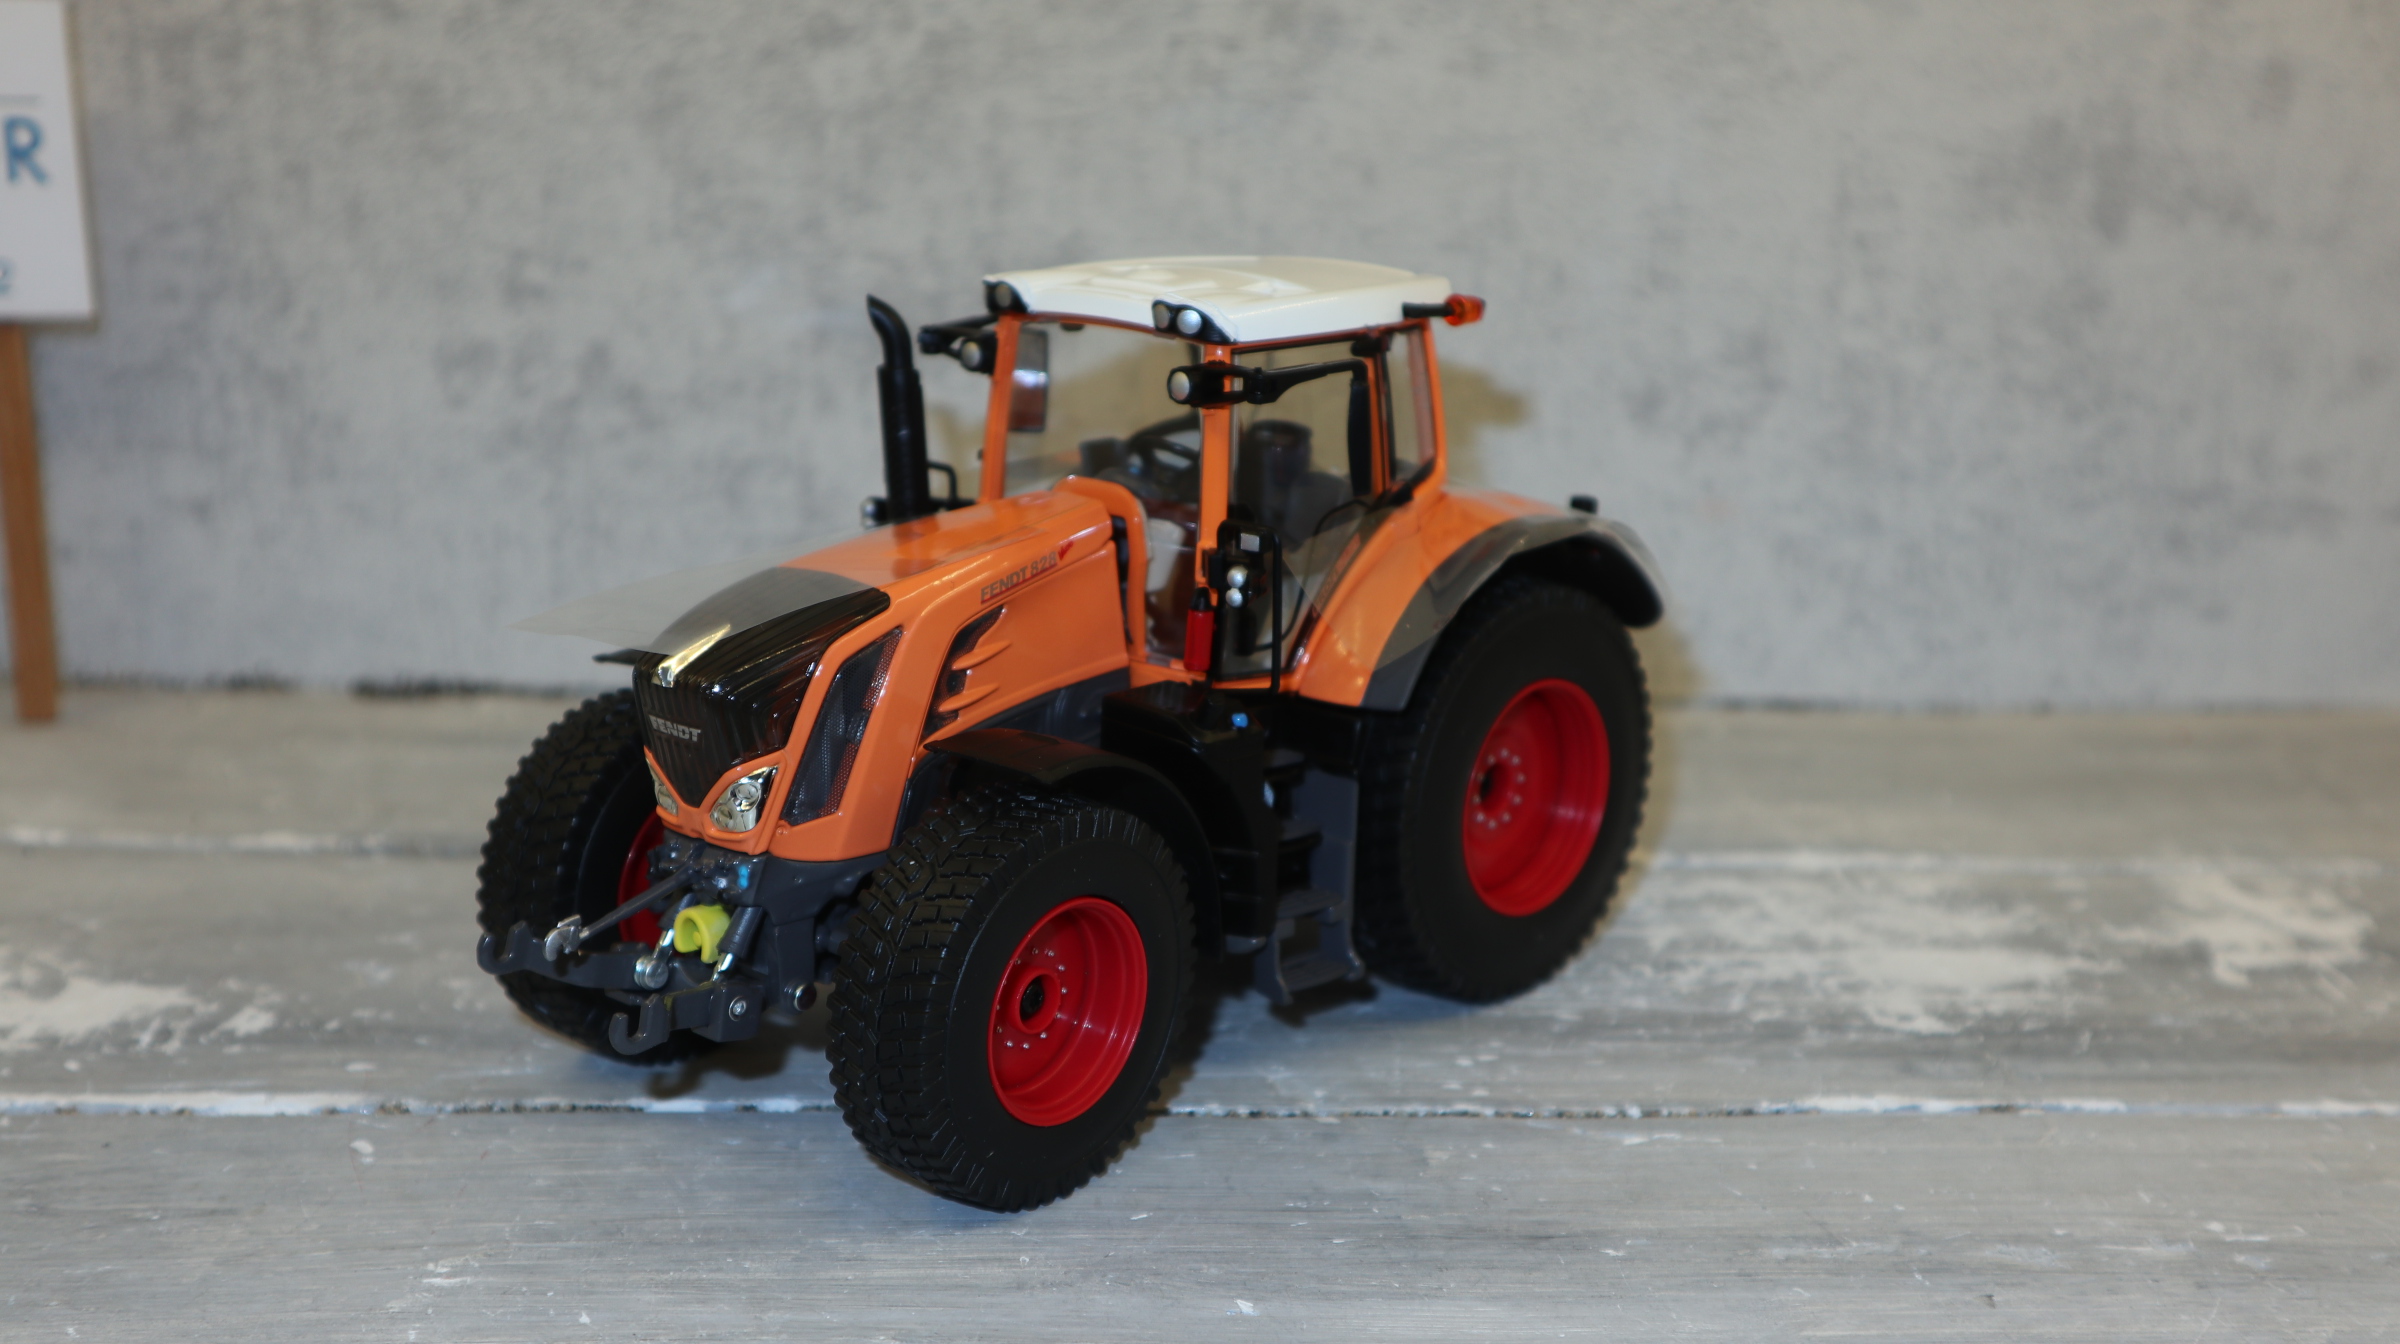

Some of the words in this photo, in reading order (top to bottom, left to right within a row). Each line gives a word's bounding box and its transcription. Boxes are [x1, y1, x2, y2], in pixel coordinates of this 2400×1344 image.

[980, 565, 1028, 602] FENDT
[1030, 551, 1058, 577] 828
[648, 714, 701, 742] FENDT
